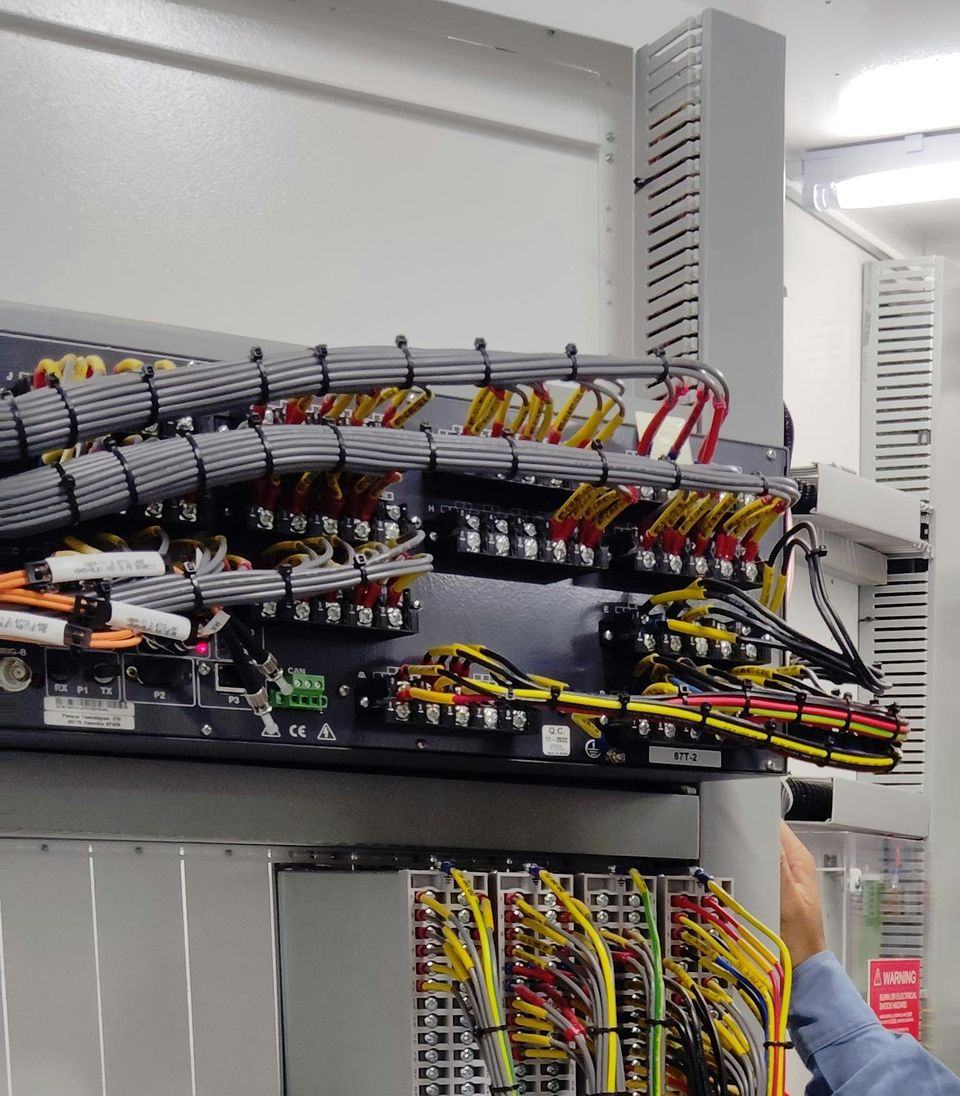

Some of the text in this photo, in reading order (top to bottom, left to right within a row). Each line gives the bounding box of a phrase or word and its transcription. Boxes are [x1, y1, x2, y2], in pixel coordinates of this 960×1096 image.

[287, 667, 306, 675] CAN
[54, 683, 68, 692] RX
[76, 685, 88, 694] P1
[99, 686, 113, 695] TX
[153, 690, 166, 699] P2
[228, 696, 240, 705] P3
[673, 751, 698, 762] 87T-2
[882, 970, 917, 986] WARNING
